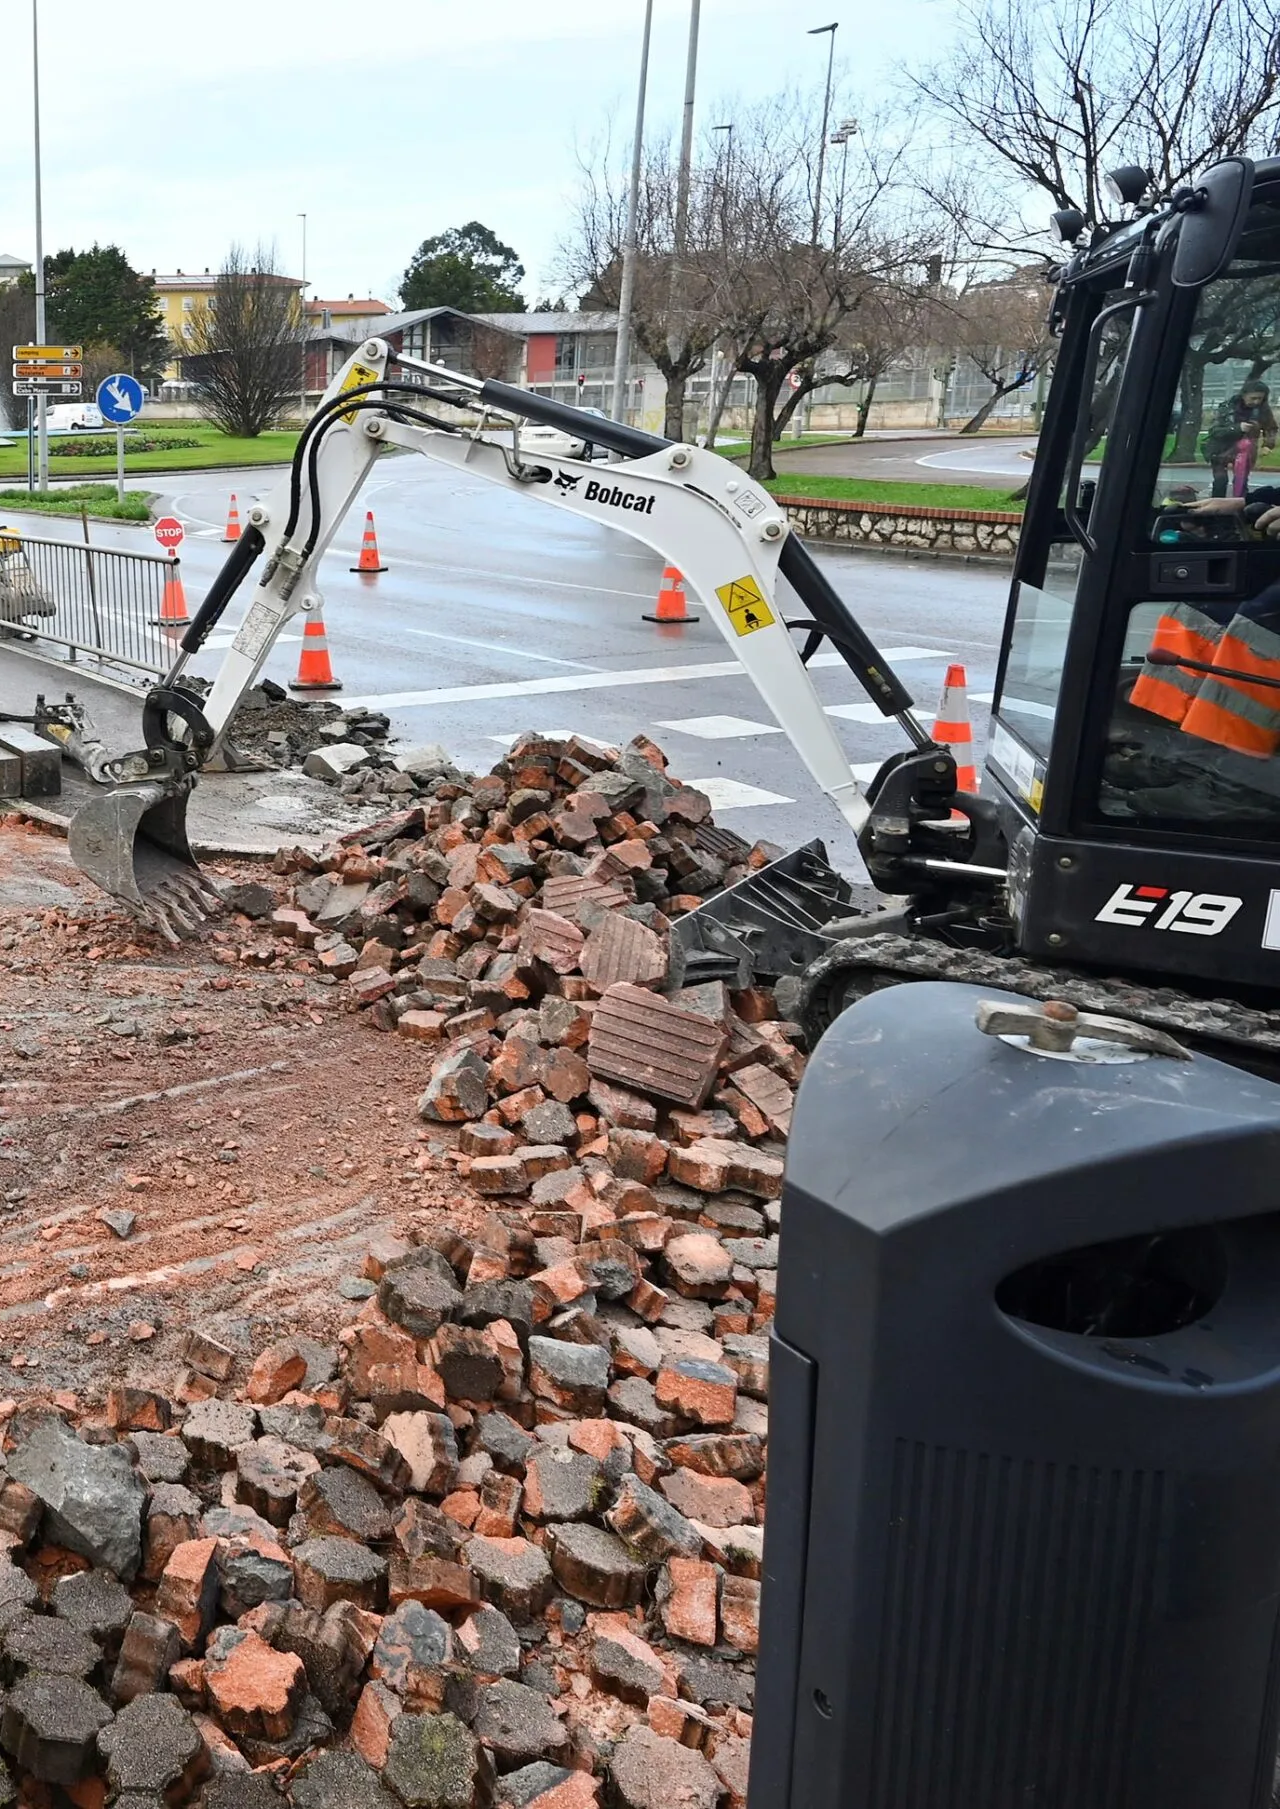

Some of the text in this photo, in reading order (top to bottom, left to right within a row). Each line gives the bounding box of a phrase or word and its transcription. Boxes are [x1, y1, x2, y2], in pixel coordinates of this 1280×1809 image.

[584, 480, 656, 515] Bobcat
[156, 527, 182, 538] STOP
[1094, 883, 1244, 936] E19
